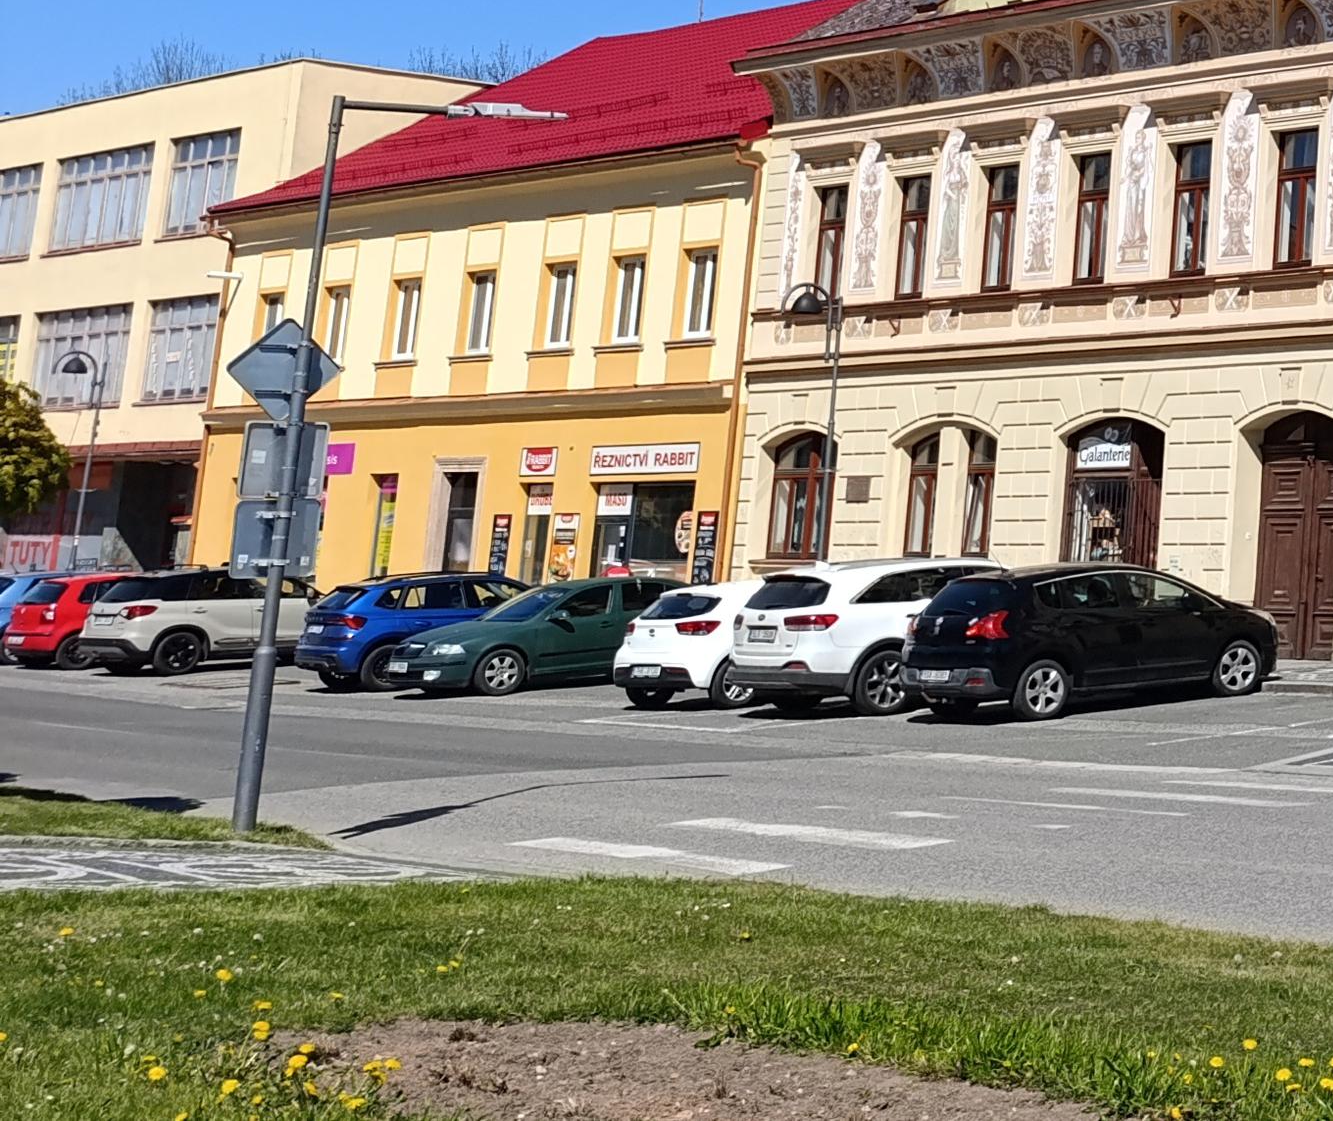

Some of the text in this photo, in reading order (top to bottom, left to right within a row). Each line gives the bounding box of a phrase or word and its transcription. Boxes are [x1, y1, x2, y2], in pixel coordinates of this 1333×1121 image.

[593, 450, 696, 468] ŘEZNICTVÍ RABBIT
[1080, 446, 1131, 465] Galanterie
